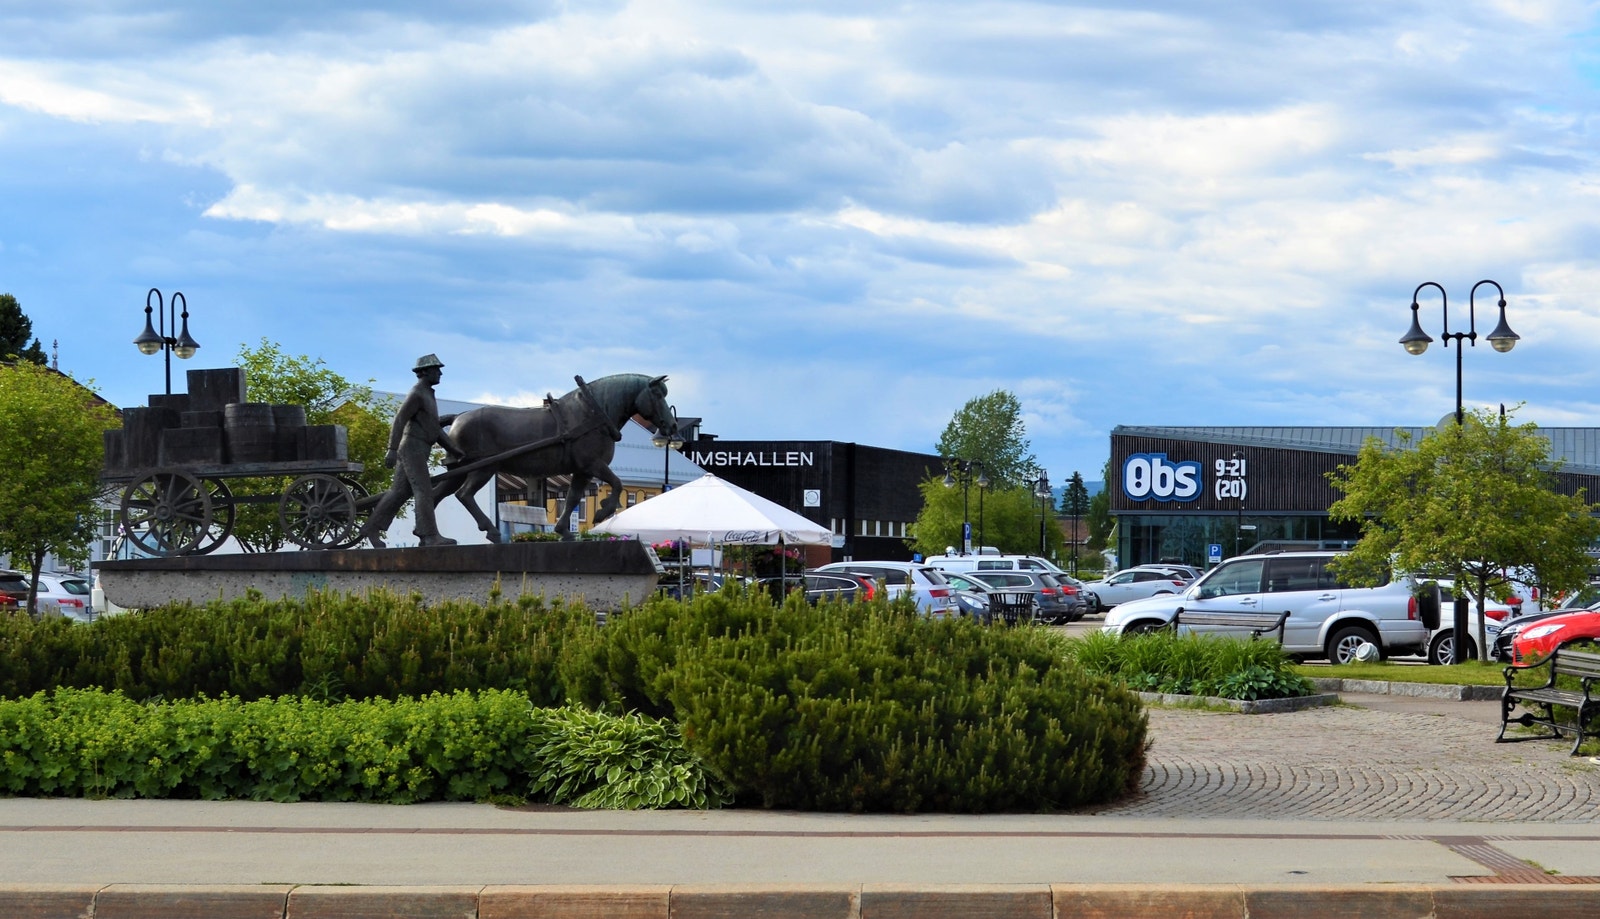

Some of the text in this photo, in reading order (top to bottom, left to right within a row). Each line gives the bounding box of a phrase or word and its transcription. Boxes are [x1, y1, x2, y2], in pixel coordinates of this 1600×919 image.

[1126, 458, 1197, 497] Obs
[1215, 459, 1246, 476] 9-21
[1215, 478, 1247, 501] (20)
[1211, 546, 1218, 555] P
